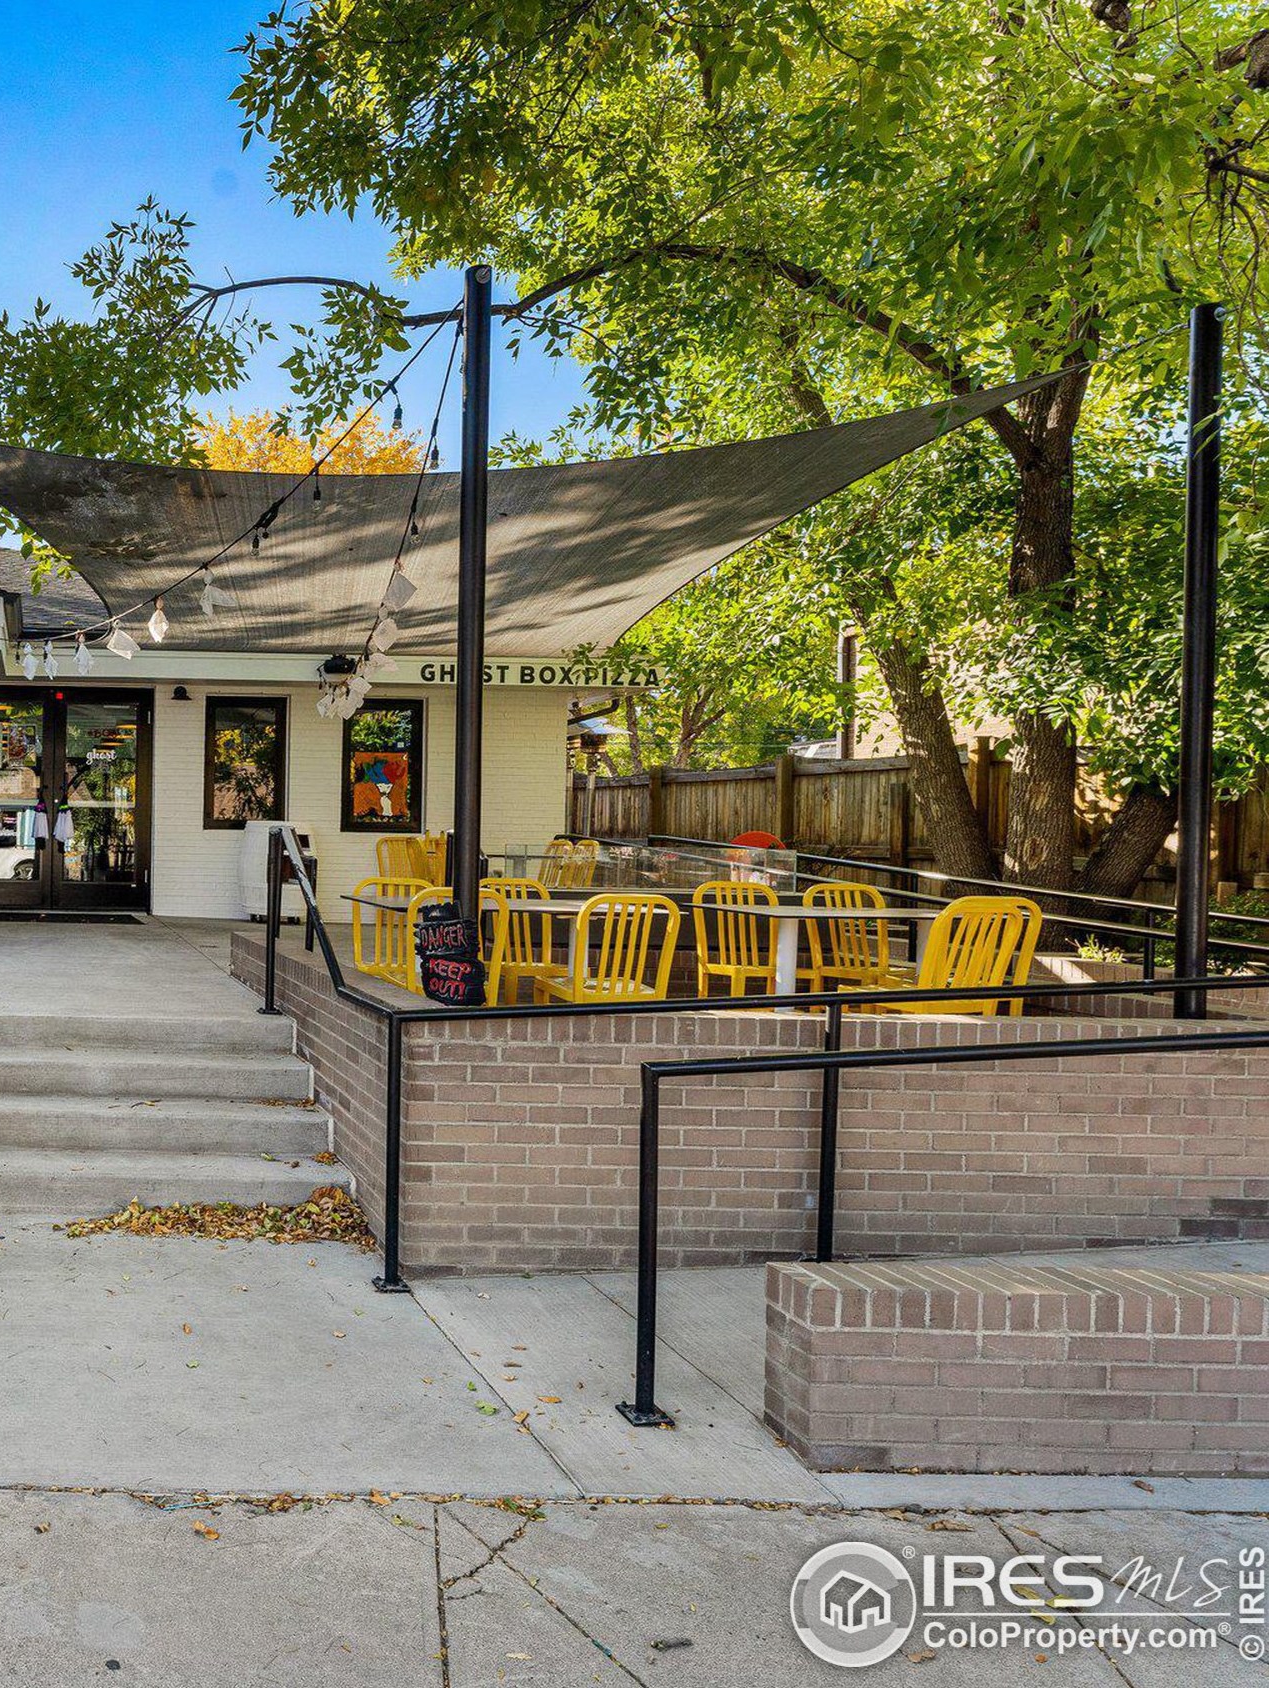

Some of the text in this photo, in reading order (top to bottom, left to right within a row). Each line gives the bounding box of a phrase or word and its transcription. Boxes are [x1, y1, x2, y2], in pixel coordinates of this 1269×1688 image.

[420, 663, 509, 684] GHST
[519, 665, 575, 686] BOX
[85, 748, 117, 766] ghost
[419, 923, 468, 950] DANGER
[428, 958, 472, 981] KEEP
